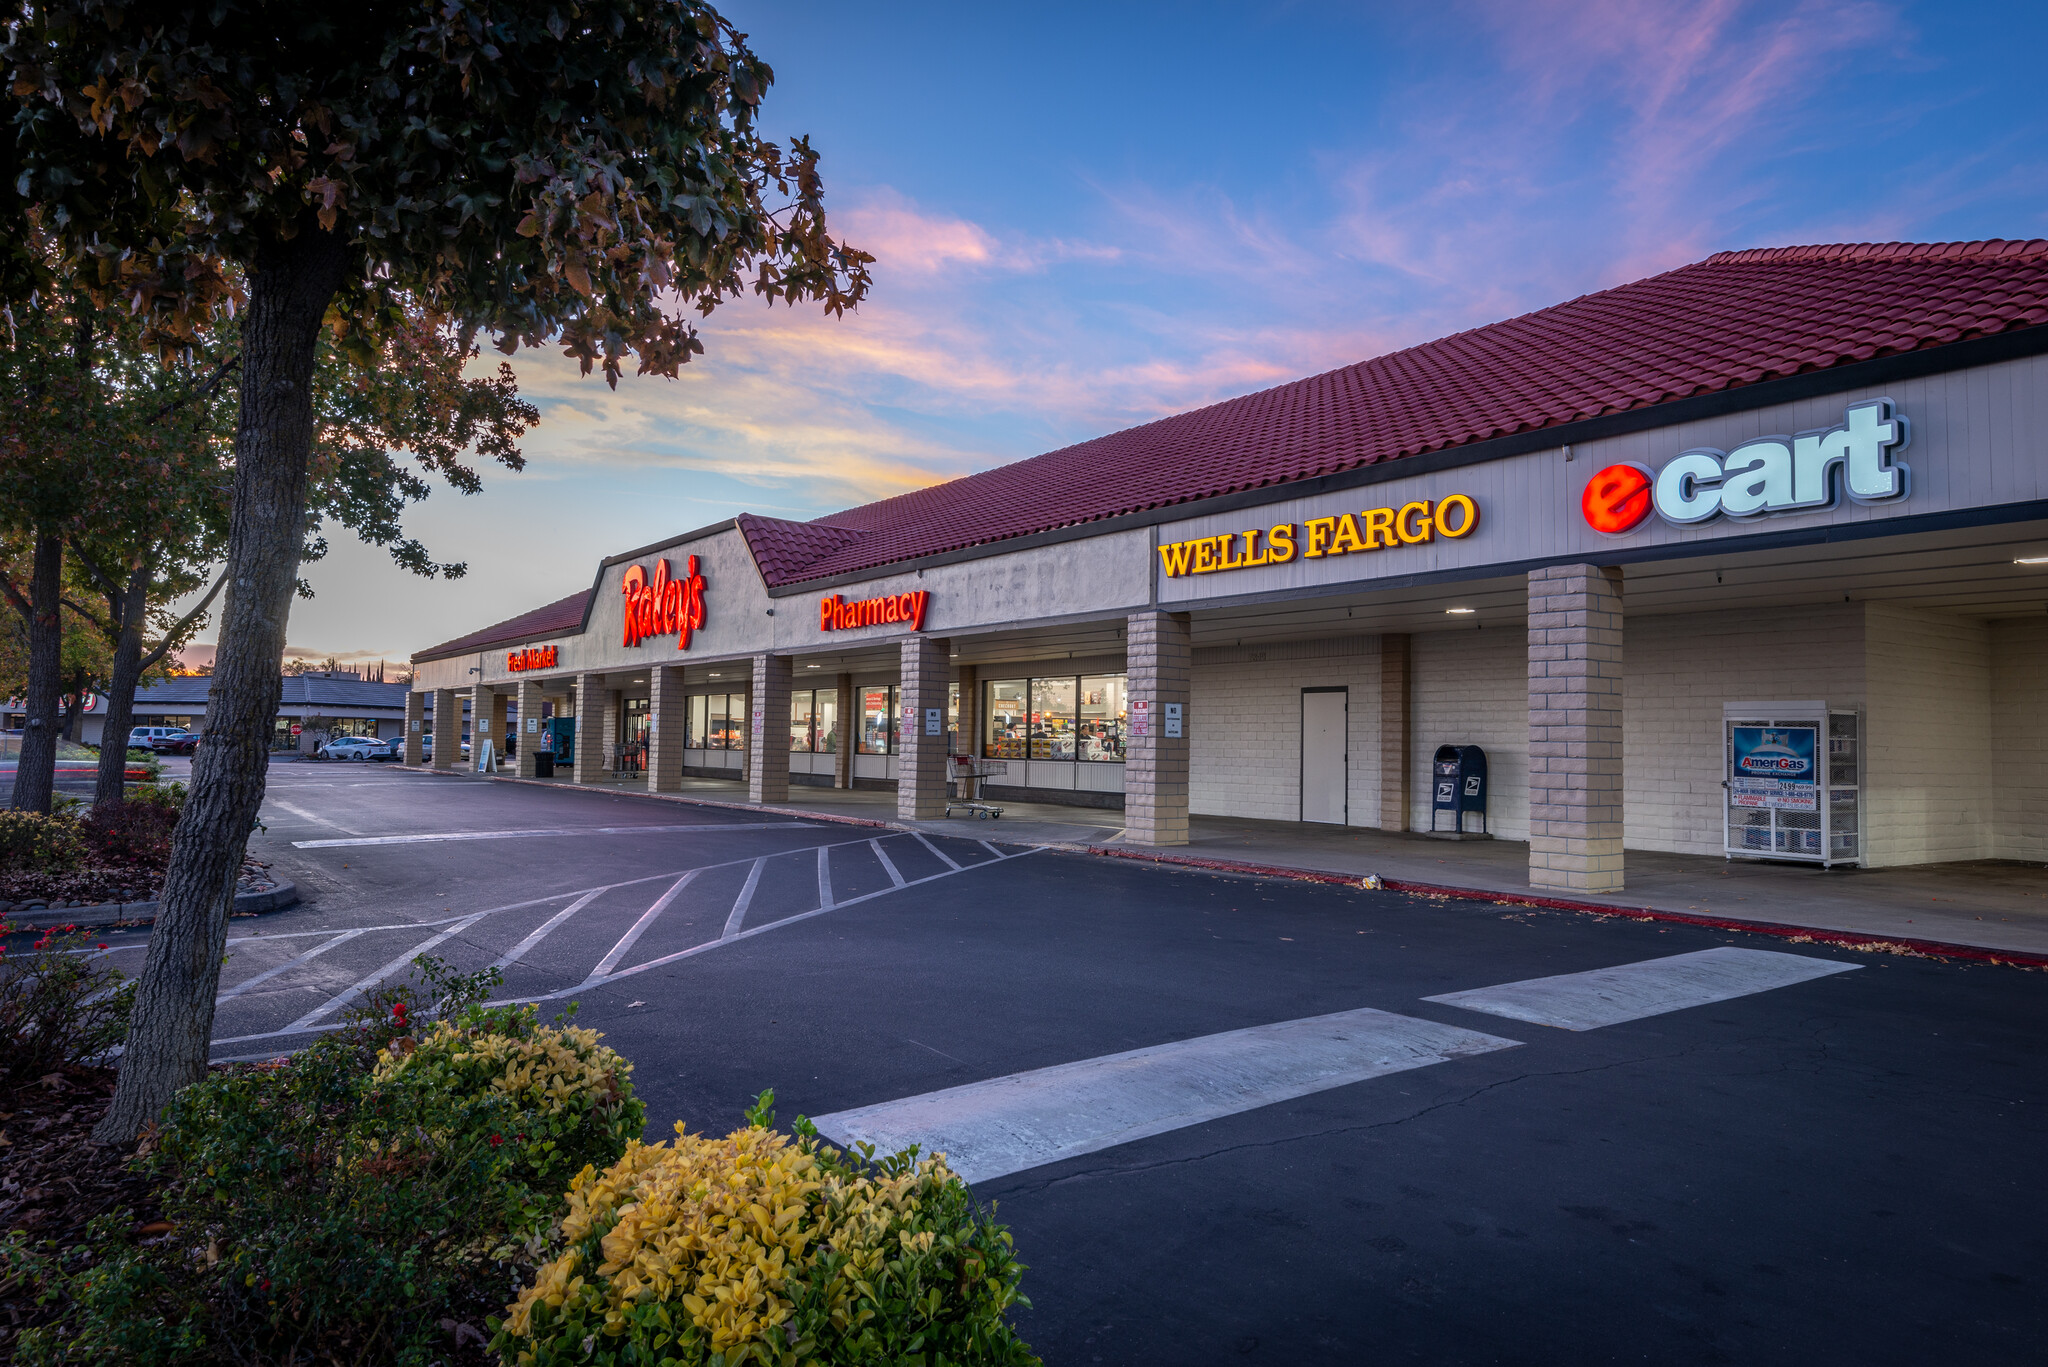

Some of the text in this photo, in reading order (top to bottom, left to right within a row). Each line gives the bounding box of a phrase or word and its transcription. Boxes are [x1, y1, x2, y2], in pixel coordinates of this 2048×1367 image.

[1158, 494, 1481, 578] WELLS FARGO
[622, 554, 706, 650] Raley's
[820, 590, 929, 632] Pharmacy
[507, 645, 557, 672] Fresh Market
[1742, 757, 1804, 769] AmeriGas
